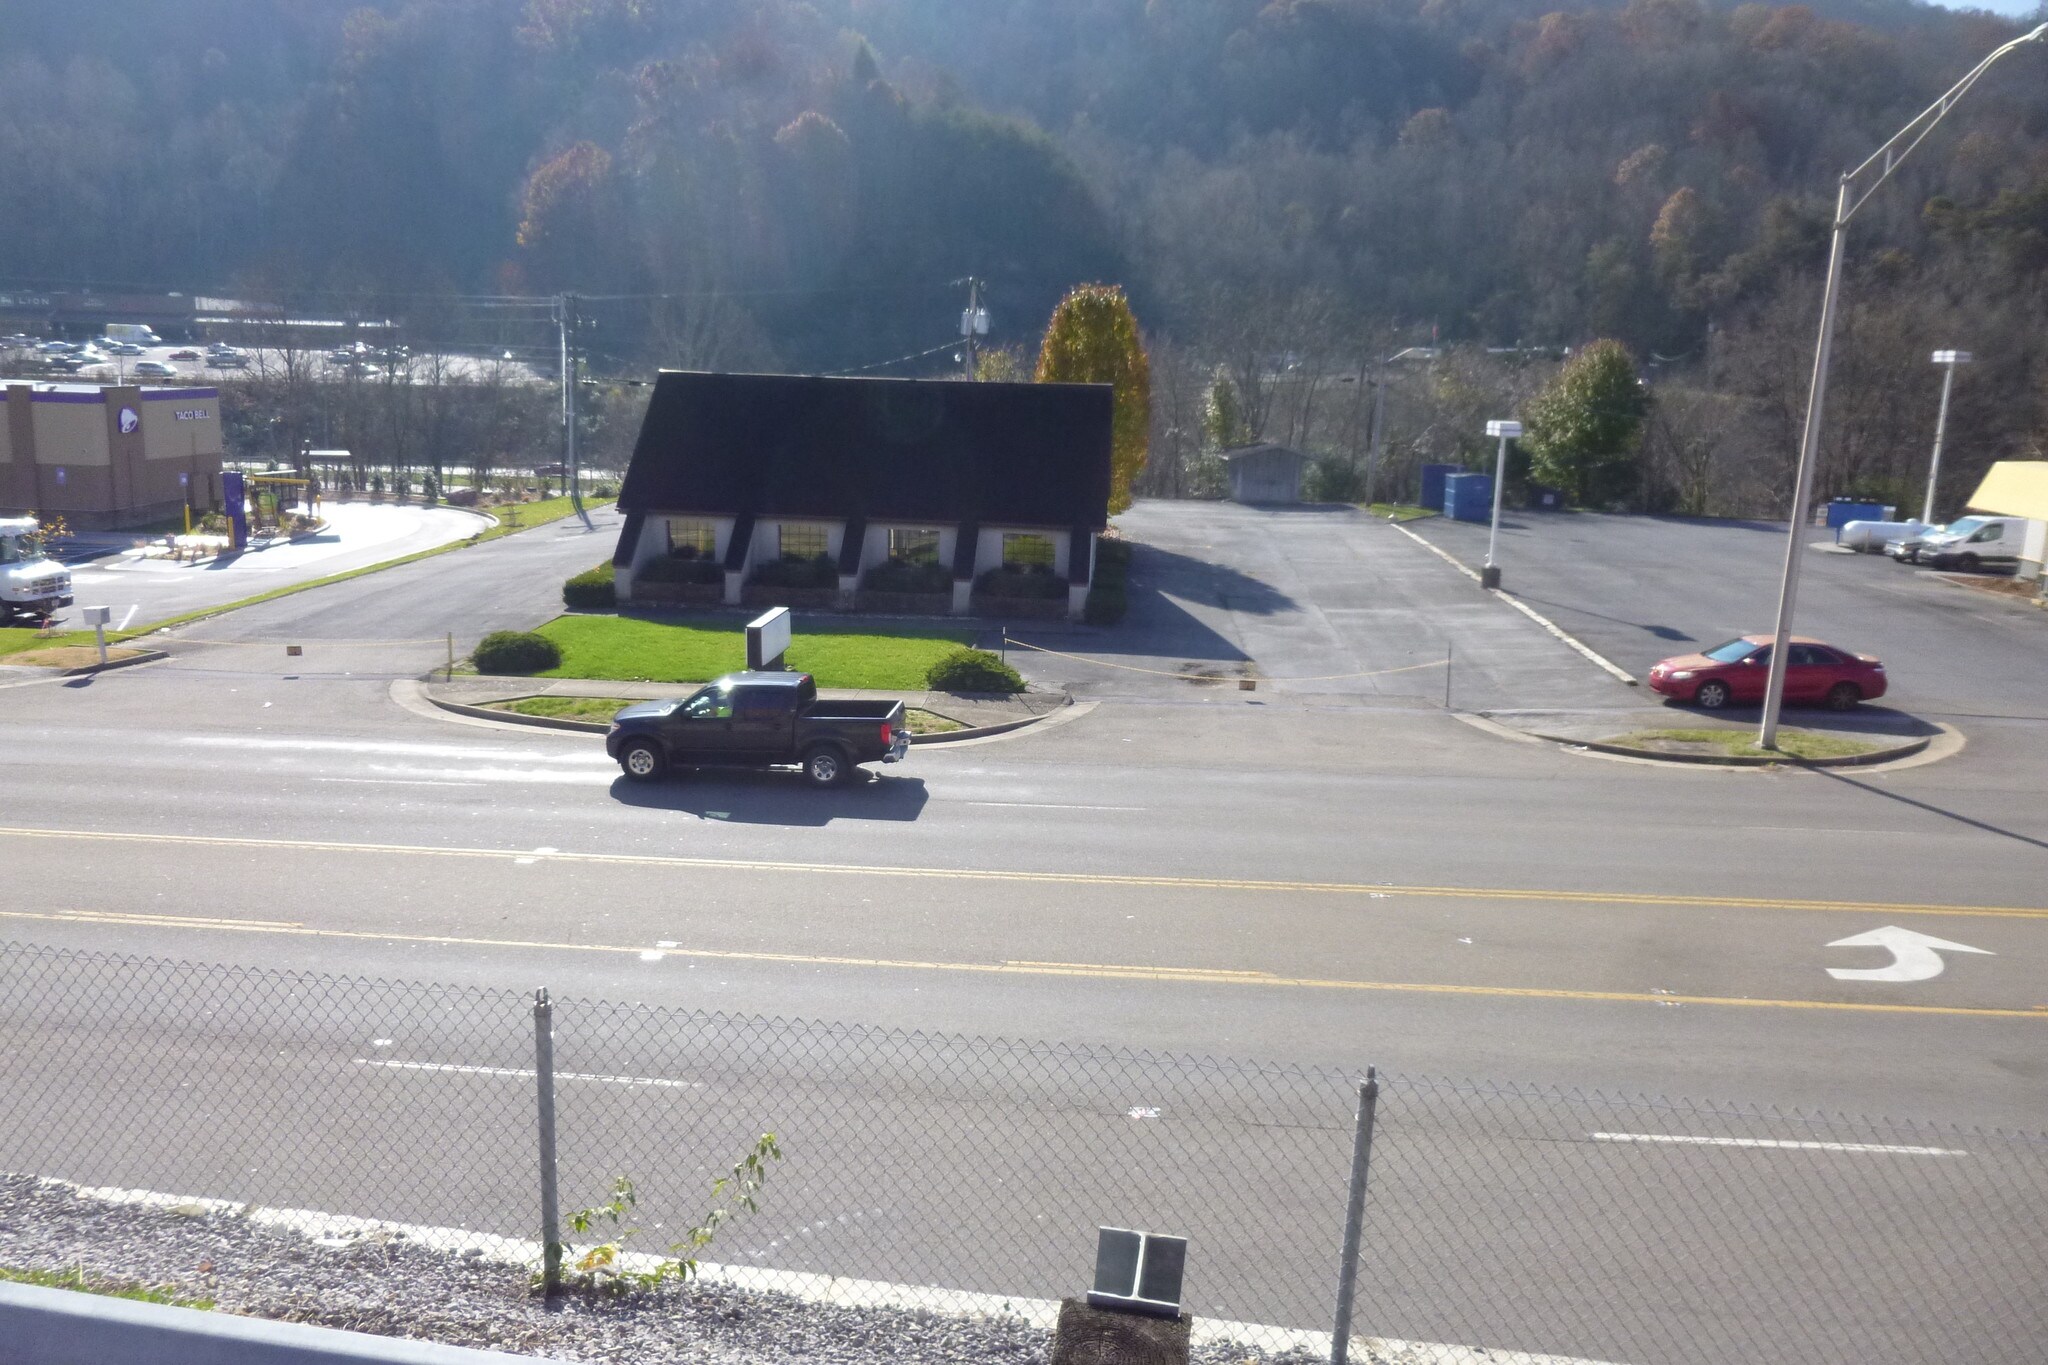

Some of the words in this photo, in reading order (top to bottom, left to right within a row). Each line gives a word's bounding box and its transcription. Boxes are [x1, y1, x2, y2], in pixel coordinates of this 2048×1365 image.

[18, 297, 50, 305] LION
[175, 410, 193, 420] TACO
[194, 409, 210, 419] BELL
